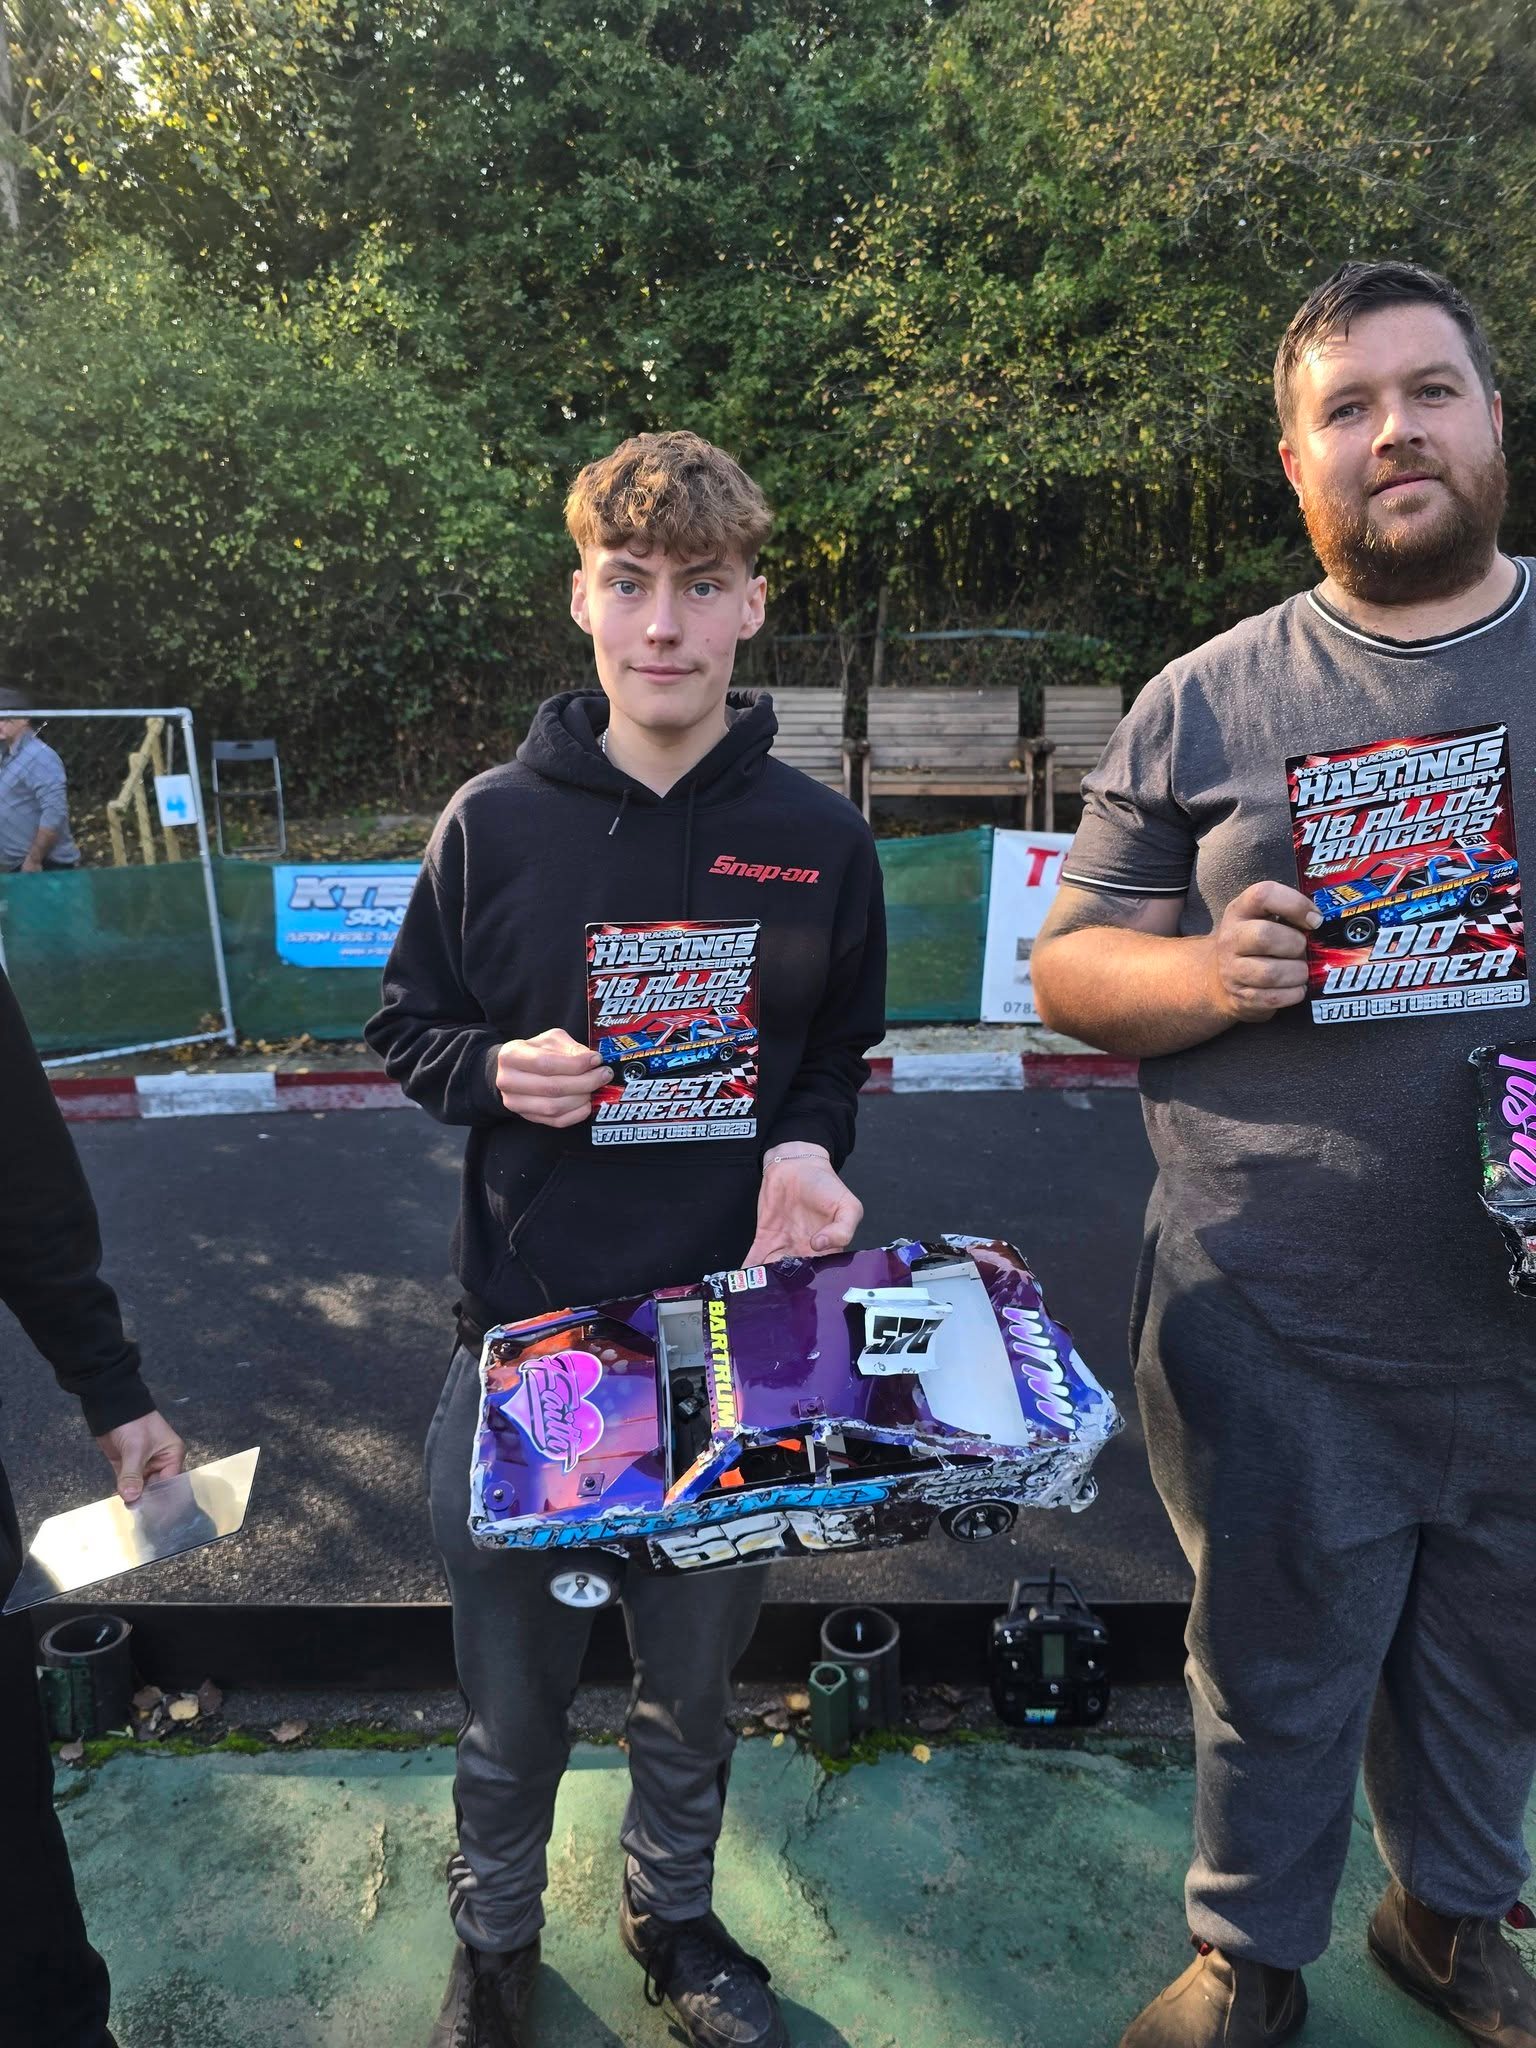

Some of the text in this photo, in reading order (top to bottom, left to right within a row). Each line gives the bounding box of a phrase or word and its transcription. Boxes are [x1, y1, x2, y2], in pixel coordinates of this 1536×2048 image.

[1297, 738, 1504, 807] HASTINGS
[1299, 749, 1407, 777] HOOKED RACING
[1388, 768, 1506, 801] RACEWAY
[1364, 784, 1502, 834] ALLOY
[1309, 808, 1497, 866] BANGERS
[709, 855, 820, 884] Snap-on
[1026, 847, 1068, 887] T
[1304, 858, 1350, 878] Round
[1400, 893, 1458, 922] 264
[644, 930, 683, 940] RACING
[593, 933, 757, 967] HASTINGS
[666, 956, 757, 972] RACEWAY
[645, 969, 752, 995] ALLOY
[1322, 948, 1517, 995] WINNER
[599, 987, 746, 1016] BANGERS
[1320, 1000, 1367, 1020] 17TH
[1370, 991, 1464, 1016] OCTOBER
[594, 1015, 631, 1027] Round
[666, 1048, 711, 1068] 264
[620, 1075, 733, 1102] BEST
[595, 1097, 755, 1122] WRECKER
[596, 1127, 634, 1142] 17TH
[637, 1124, 708, 1140] OCTOBER
[866, 1315, 944, 1355] 576
[708, 1300, 736, 1429] BARTRUM
[521, 1353, 582, 1471] Faith
